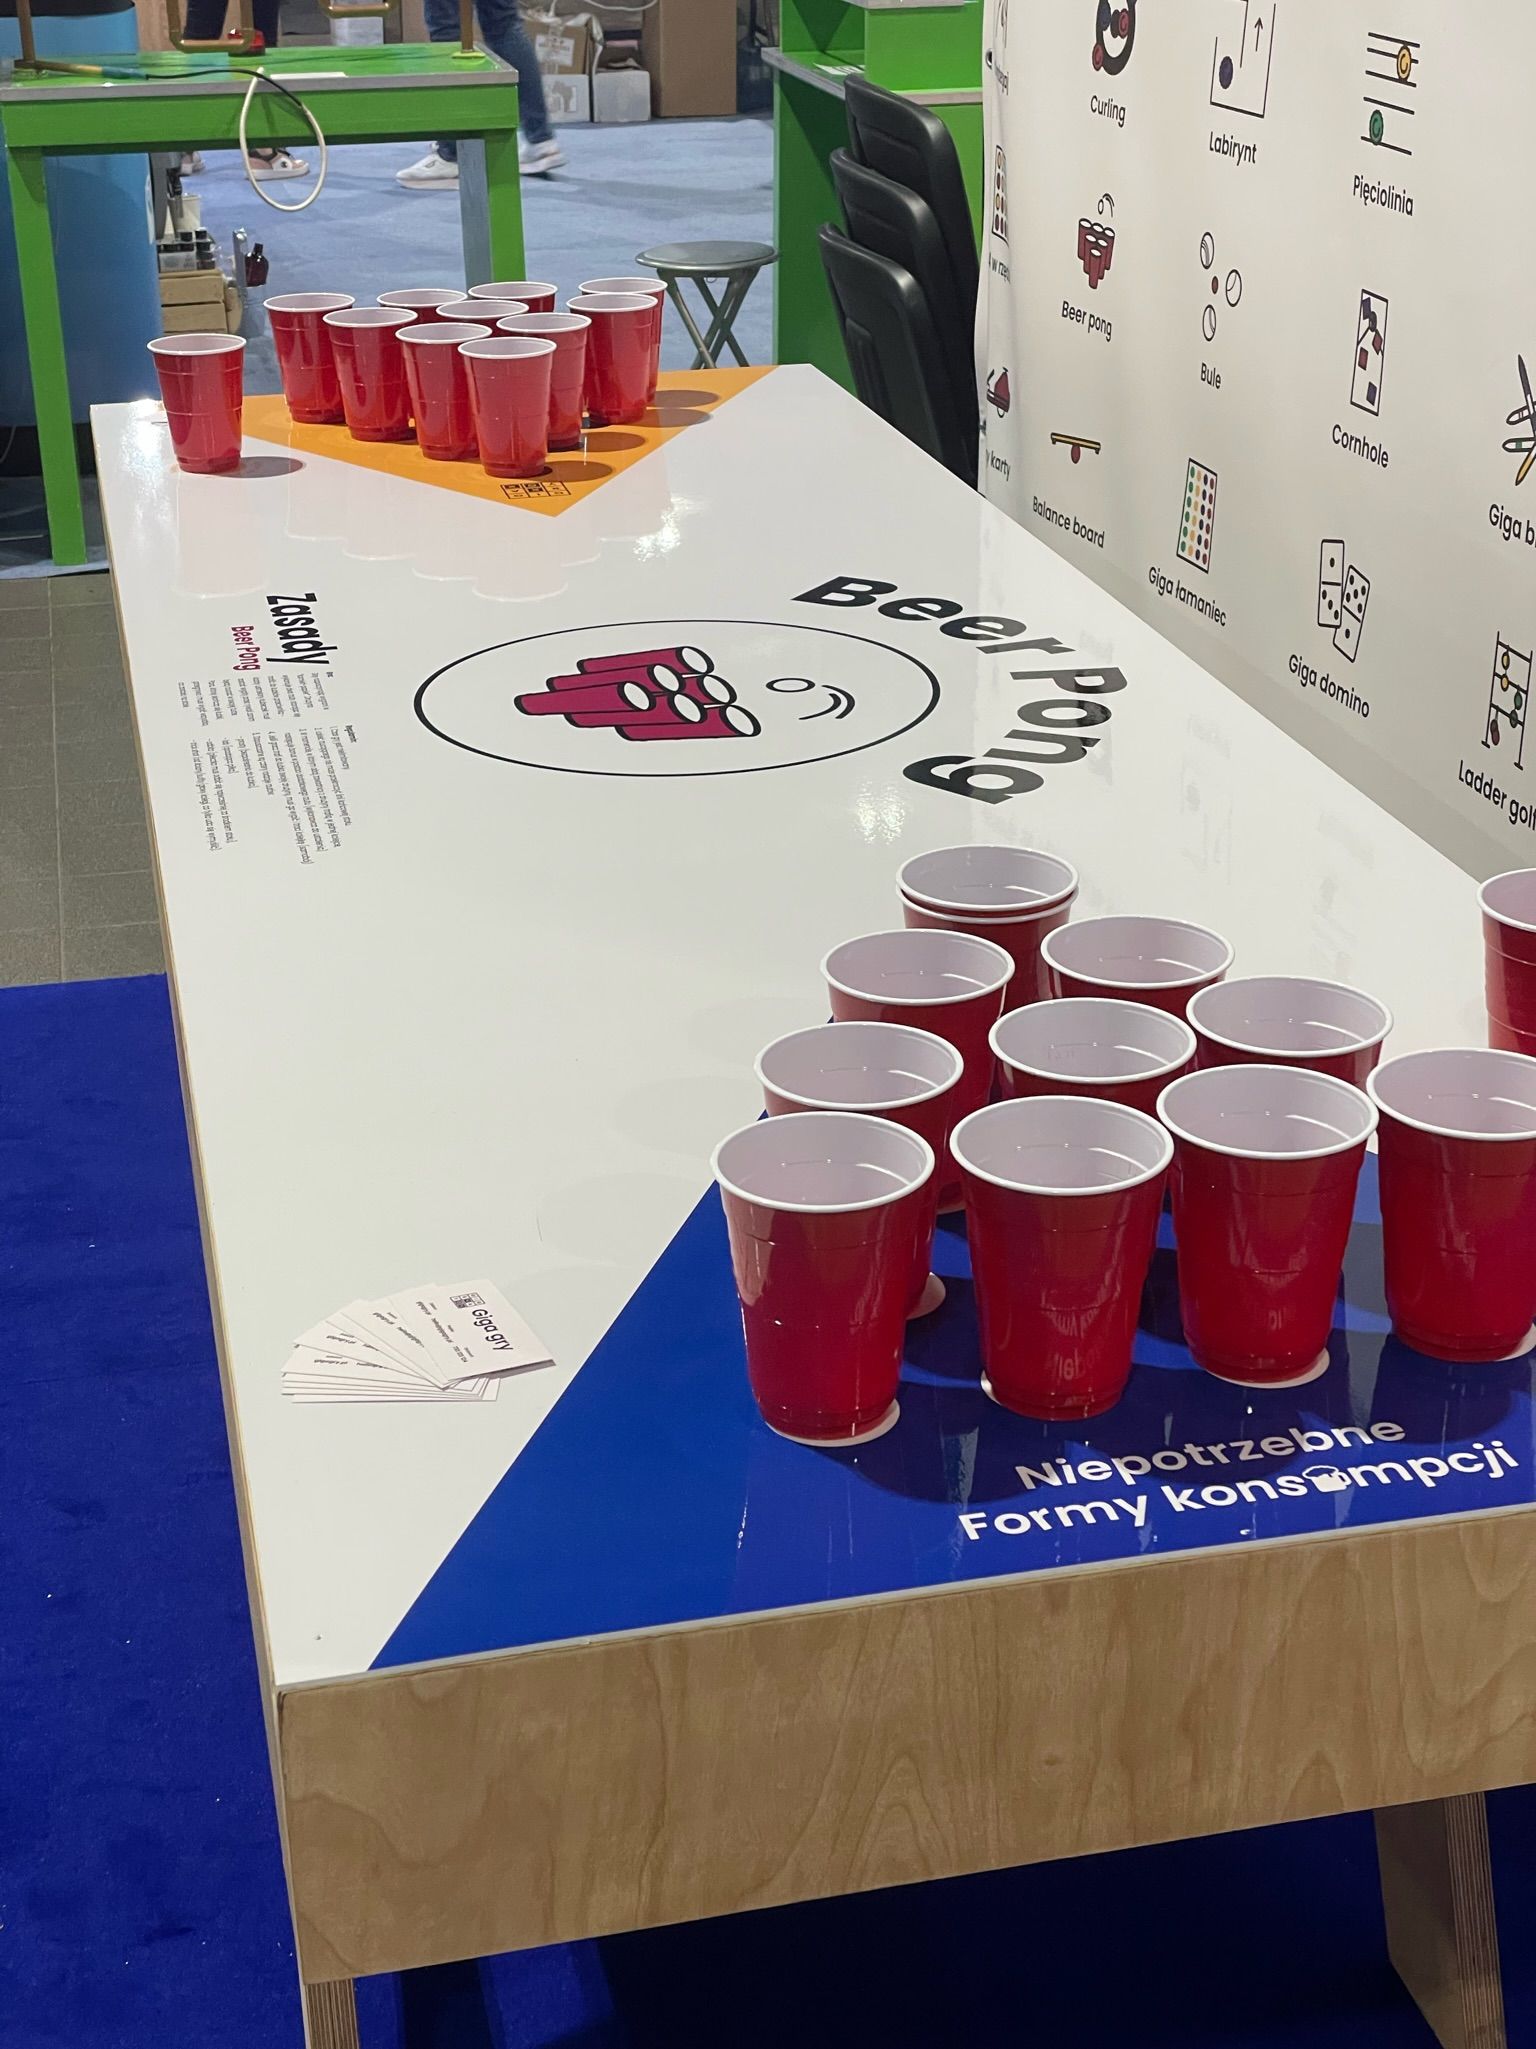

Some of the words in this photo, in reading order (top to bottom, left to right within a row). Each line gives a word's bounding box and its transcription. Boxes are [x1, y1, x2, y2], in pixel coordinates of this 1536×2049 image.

[1090, 95, 1126, 128] Curling
[1209, 131, 1257, 166] Labirynt
[1352, 174, 1414, 217] Pięciolinia
[1062, 301, 1088, 325] Beer
[1088, 313, 1113, 342] pong
[1200, 362, 1222, 390] Bule
[990, 449, 1011, 482] karty
[1332, 424, 1390, 468] Cornhole
[1032, 496, 1071, 531] Balance
[1072, 516, 1105, 548] board
[1489, 503, 1523, 542] Giga
[1524, 519, 1536, 549] b
[790, 575, 1076, 655] Beer
[1148, 566, 1174, 597] Giga
[1175, 579, 1227, 627] łamaniec
[231, 625, 255, 646] Beer
[266, 592, 338, 665] Zasady
[232, 646, 261, 671] Pong
[1288, 653, 1318, 688] Giga
[1319, 673, 1370, 719] domino
[903, 667, 1128, 805] Pong
[1458, 760, 1508, 810] Ladder
[1509, 799, 1536, 831] golf
[472, 1308, 498, 1333] Giga
[485, 1331, 514, 1351] gry
[1015, 1420, 1406, 1490] Niepotrzebne
[958, 1495, 1148, 1540] Formy
[1160, 1440, 1519, 1514] konsmpcji
